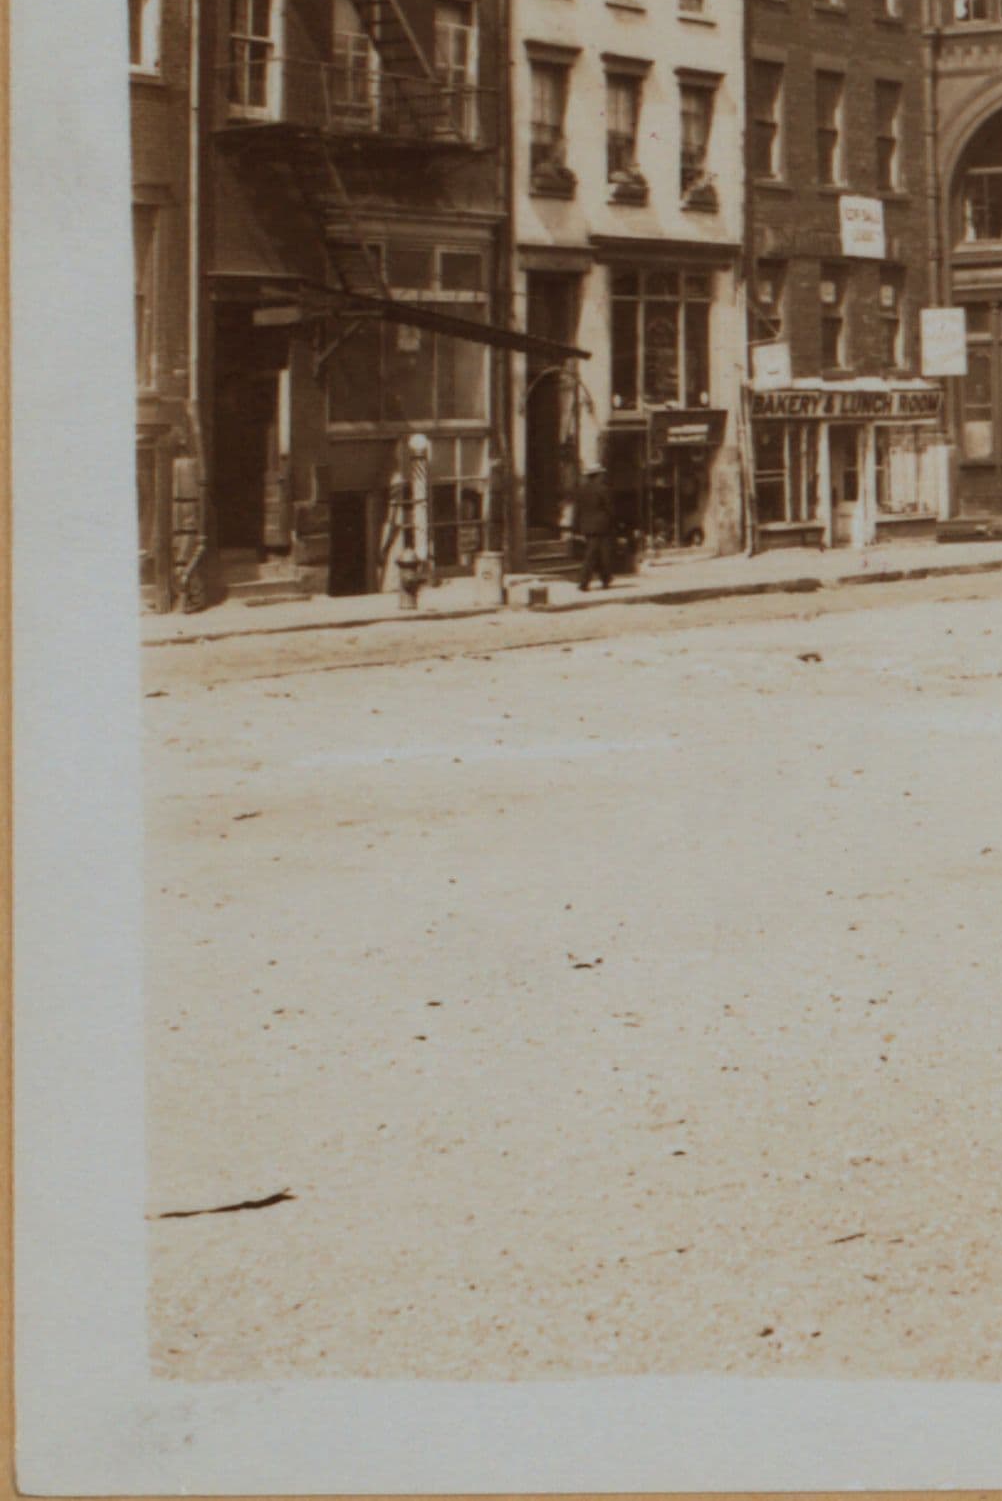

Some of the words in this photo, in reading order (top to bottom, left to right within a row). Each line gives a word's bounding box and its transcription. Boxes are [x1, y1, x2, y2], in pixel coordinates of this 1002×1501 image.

[752, 394, 820, 414] BAKERY
[823, 395, 834, 414] &
[841, 394, 891, 413] LUNCH
[900, 394, 938, 413] ROOM
